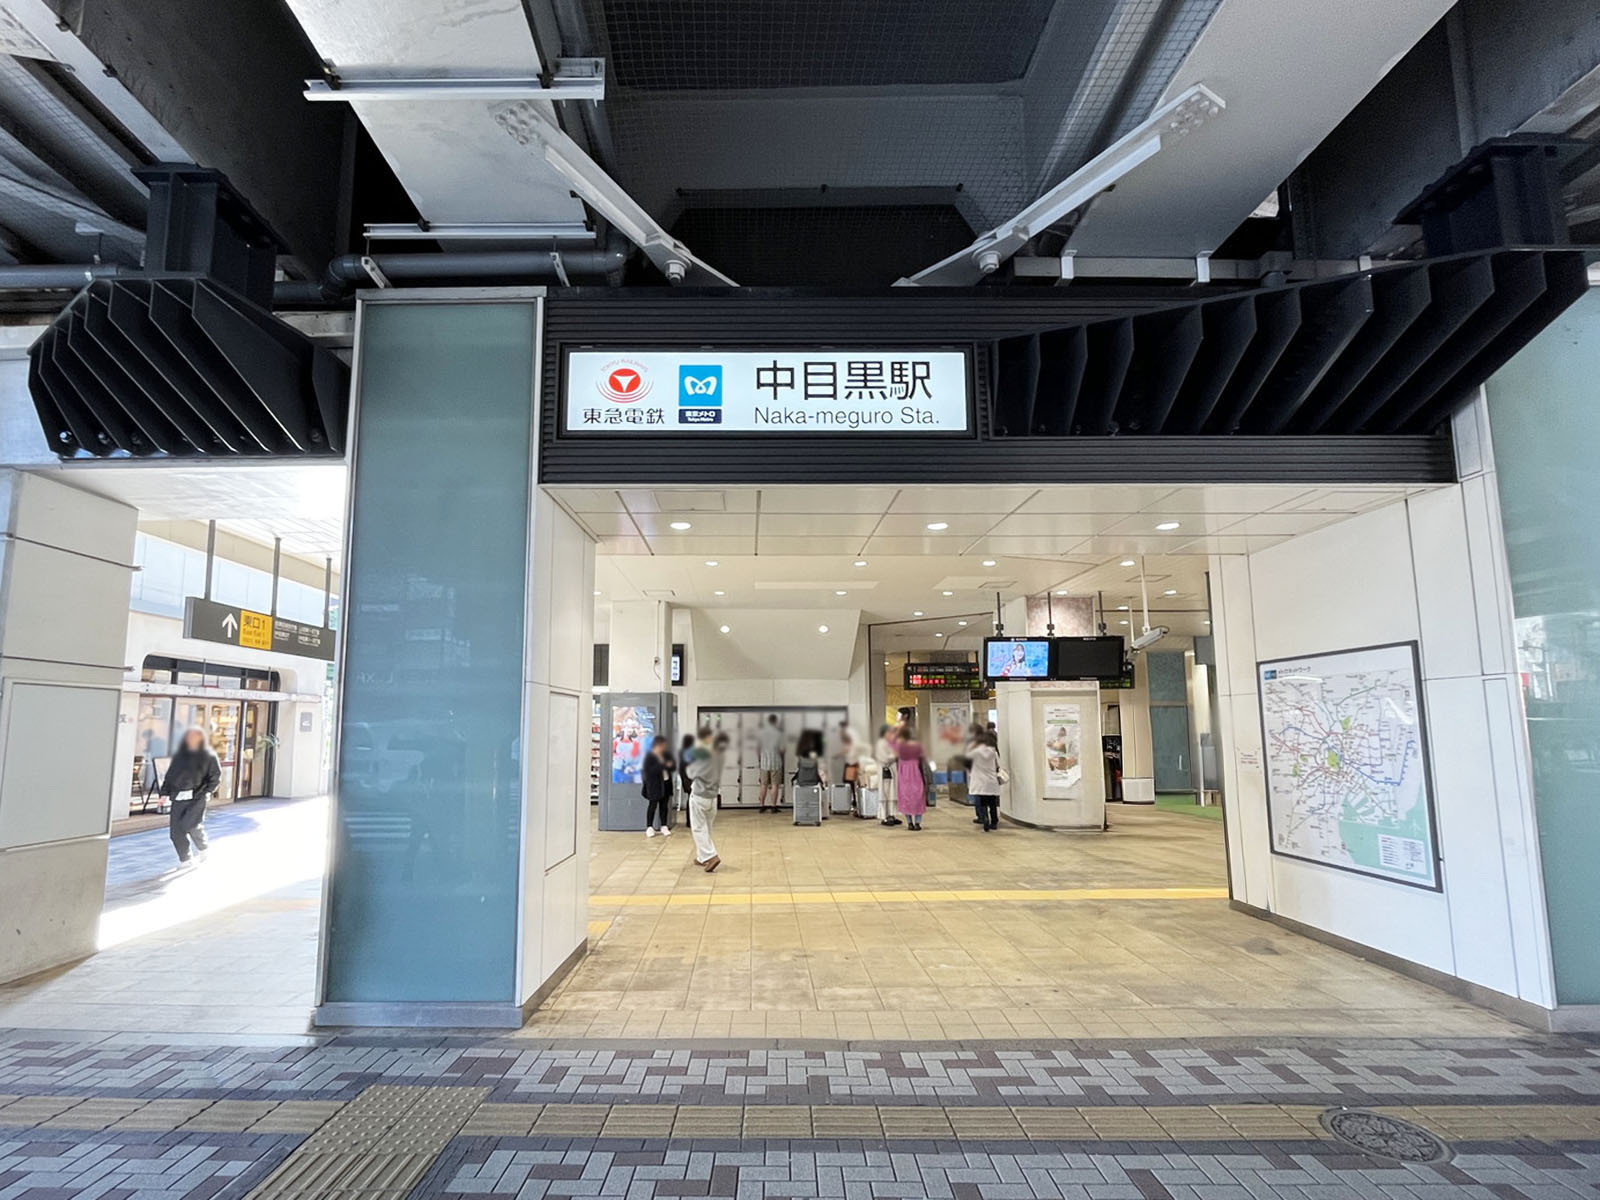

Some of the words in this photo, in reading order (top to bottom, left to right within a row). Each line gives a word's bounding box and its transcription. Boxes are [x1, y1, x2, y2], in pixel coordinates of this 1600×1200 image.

[756, 360, 932, 400] 中目黒駅
[583, 407, 665, 424] 東急電鉄
[754, 406, 893, 428] Naka-meguro
[900, 406, 940, 424] Sta.
